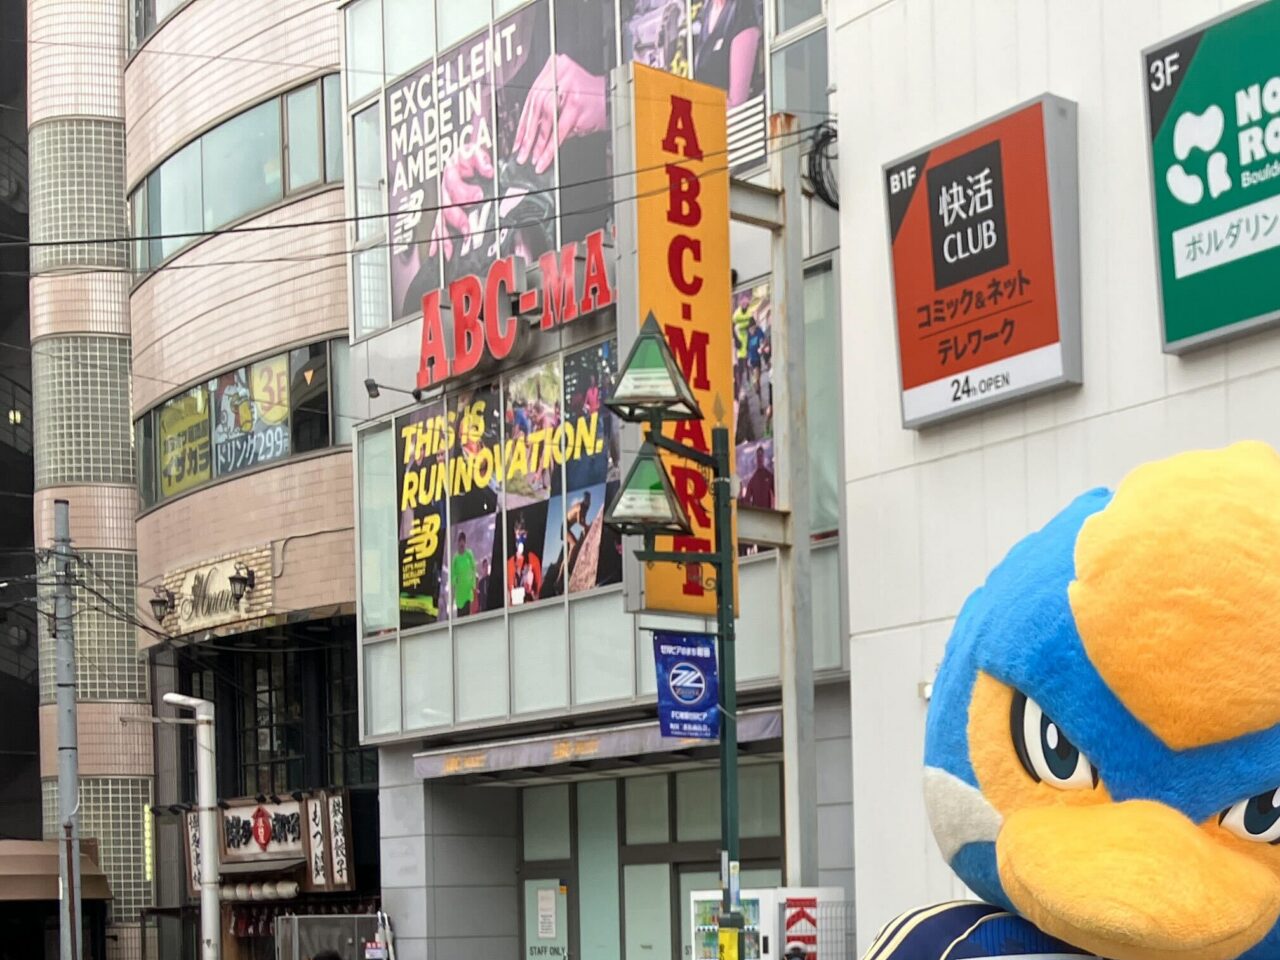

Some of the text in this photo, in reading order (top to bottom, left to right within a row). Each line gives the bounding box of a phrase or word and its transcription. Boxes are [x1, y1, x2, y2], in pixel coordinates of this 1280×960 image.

[390, 23, 523, 127] EXCELLENT.
[1150, 52, 1180, 92] 3F
[392, 81, 482, 161] MADE IN
[392, 117, 494, 197] AMERICA
[890, 165, 918, 194] B1F
[937, 166, 994, 228] 快活
[943, 218, 997, 264] CLUB
[417, 230, 617, 390] ABC-MA
[917, 268, 1031, 329] コミック&ネット
[938, 317, 1016, 366] テレワーク
[978, 372, 1010, 393] OPEN
[401, 400, 487, 464] THIS IS
[401, 411, 606, 511] RUNNOVATION.
[529, 945, 566, 956] STAFF ONLY
